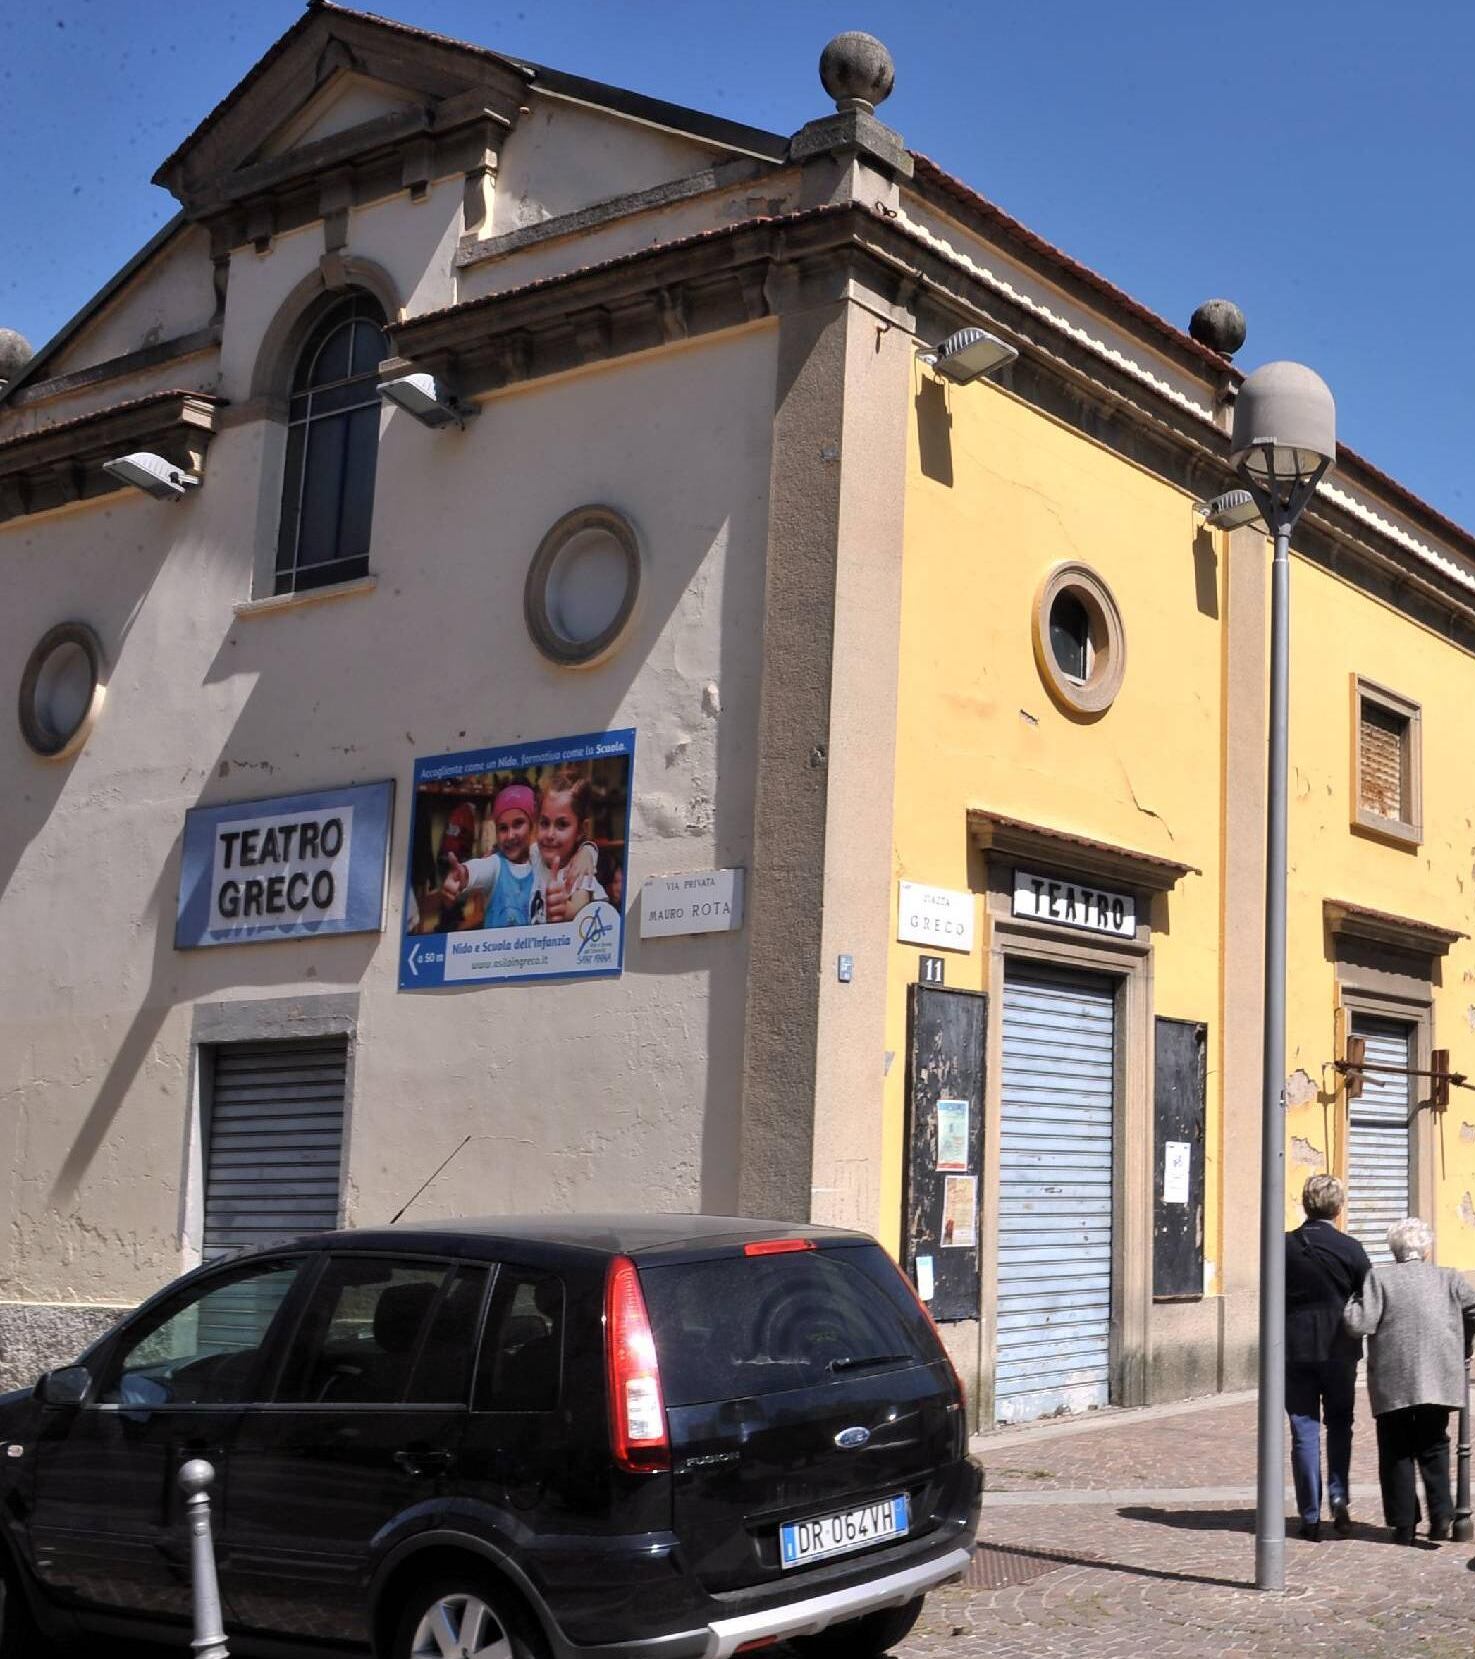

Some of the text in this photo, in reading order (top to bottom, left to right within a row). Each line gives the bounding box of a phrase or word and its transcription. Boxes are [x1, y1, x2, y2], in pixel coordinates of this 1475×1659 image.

[562, 748, 585, 759] come
[219, 817, 344, 870] TEATRO
[218, 869, 335, 919] GRECO
[665, 878, 716, 891] VIA PRIVATA
[648, 901, 732, 921] MAURO ROTA
[1031, 878, 1125, 931] TEATRO
[910, 915, 965, 936] GRECO
[452, 943, 473, 955] Nido
[482, 940, 512, 953] Scuola
[926, 958, 942, 983] 11
[799, 1520, 824, 1554] DR
[832, 1501, 894, 1544] 064VH
